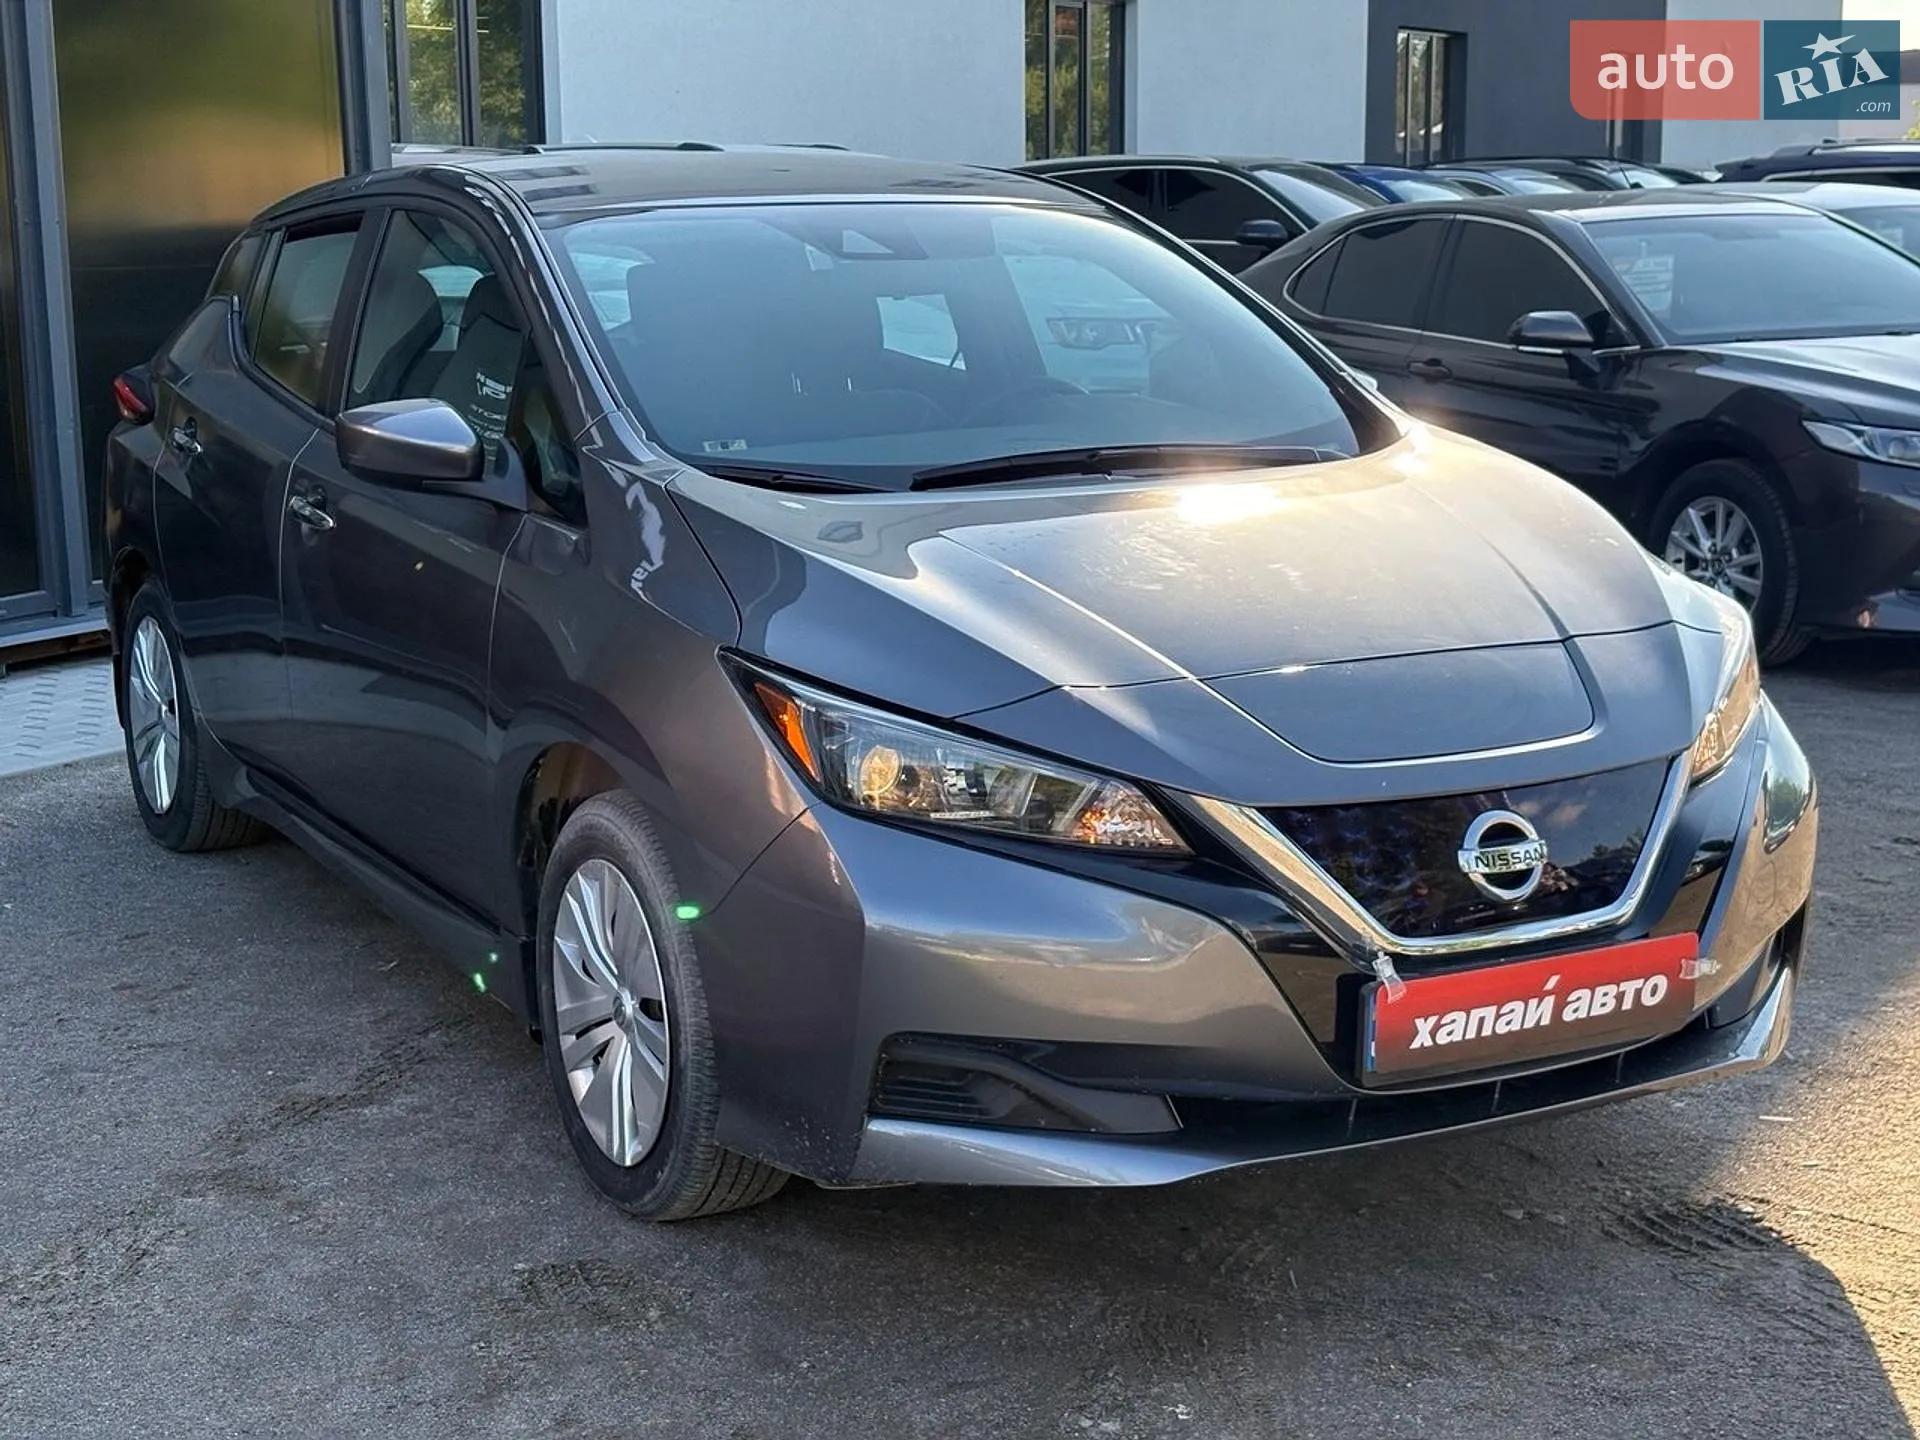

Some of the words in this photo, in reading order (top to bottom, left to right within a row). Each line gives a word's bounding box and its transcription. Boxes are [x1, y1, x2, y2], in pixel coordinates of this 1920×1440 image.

[1474, 844, 1545, 868] NISSAN
[1409, 974, 1560, 1049] хапай
[1562, 974, 1668, 1022] авто
